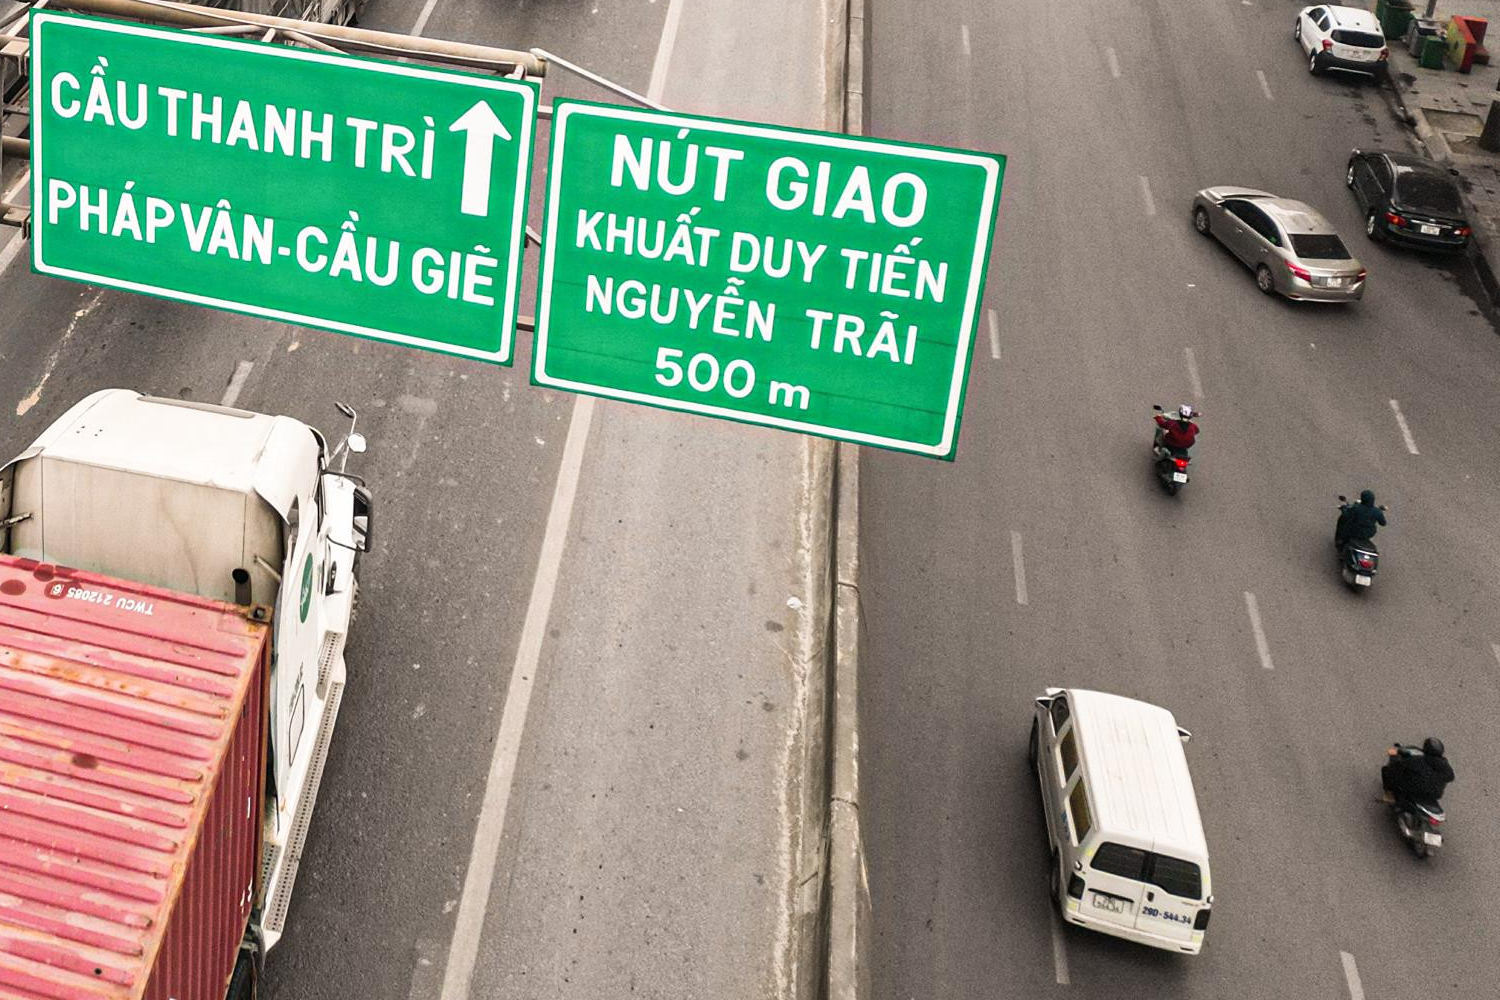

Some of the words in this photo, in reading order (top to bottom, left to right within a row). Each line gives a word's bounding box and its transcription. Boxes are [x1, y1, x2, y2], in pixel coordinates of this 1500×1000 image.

[51, 56, 148, 130] CẦU
[157, 86, 334, 162] THANH
[346, 115, 436, 181] TRÌ
[610, 127, 745, 202] NÚT
[765, 156, 928, 228] GIAO
[48, 178, 176, 244] PHÁP
[411, 244, 499, 307] GIẼ
[576, 206, 721, 267] KHUẤT
[729, 231, 827, 283] DUY
[840, 236, 948, 303] TIẾN
[585, 274, 776, 342] NGUYỄN
[805, 309, 918, 365] TRÃI
[655, 346, 756, 399] 500
[768, 380, 810, 410] m
[66, 587, 114, 606] 212085
[116, 598, 154, 616] TWCU
